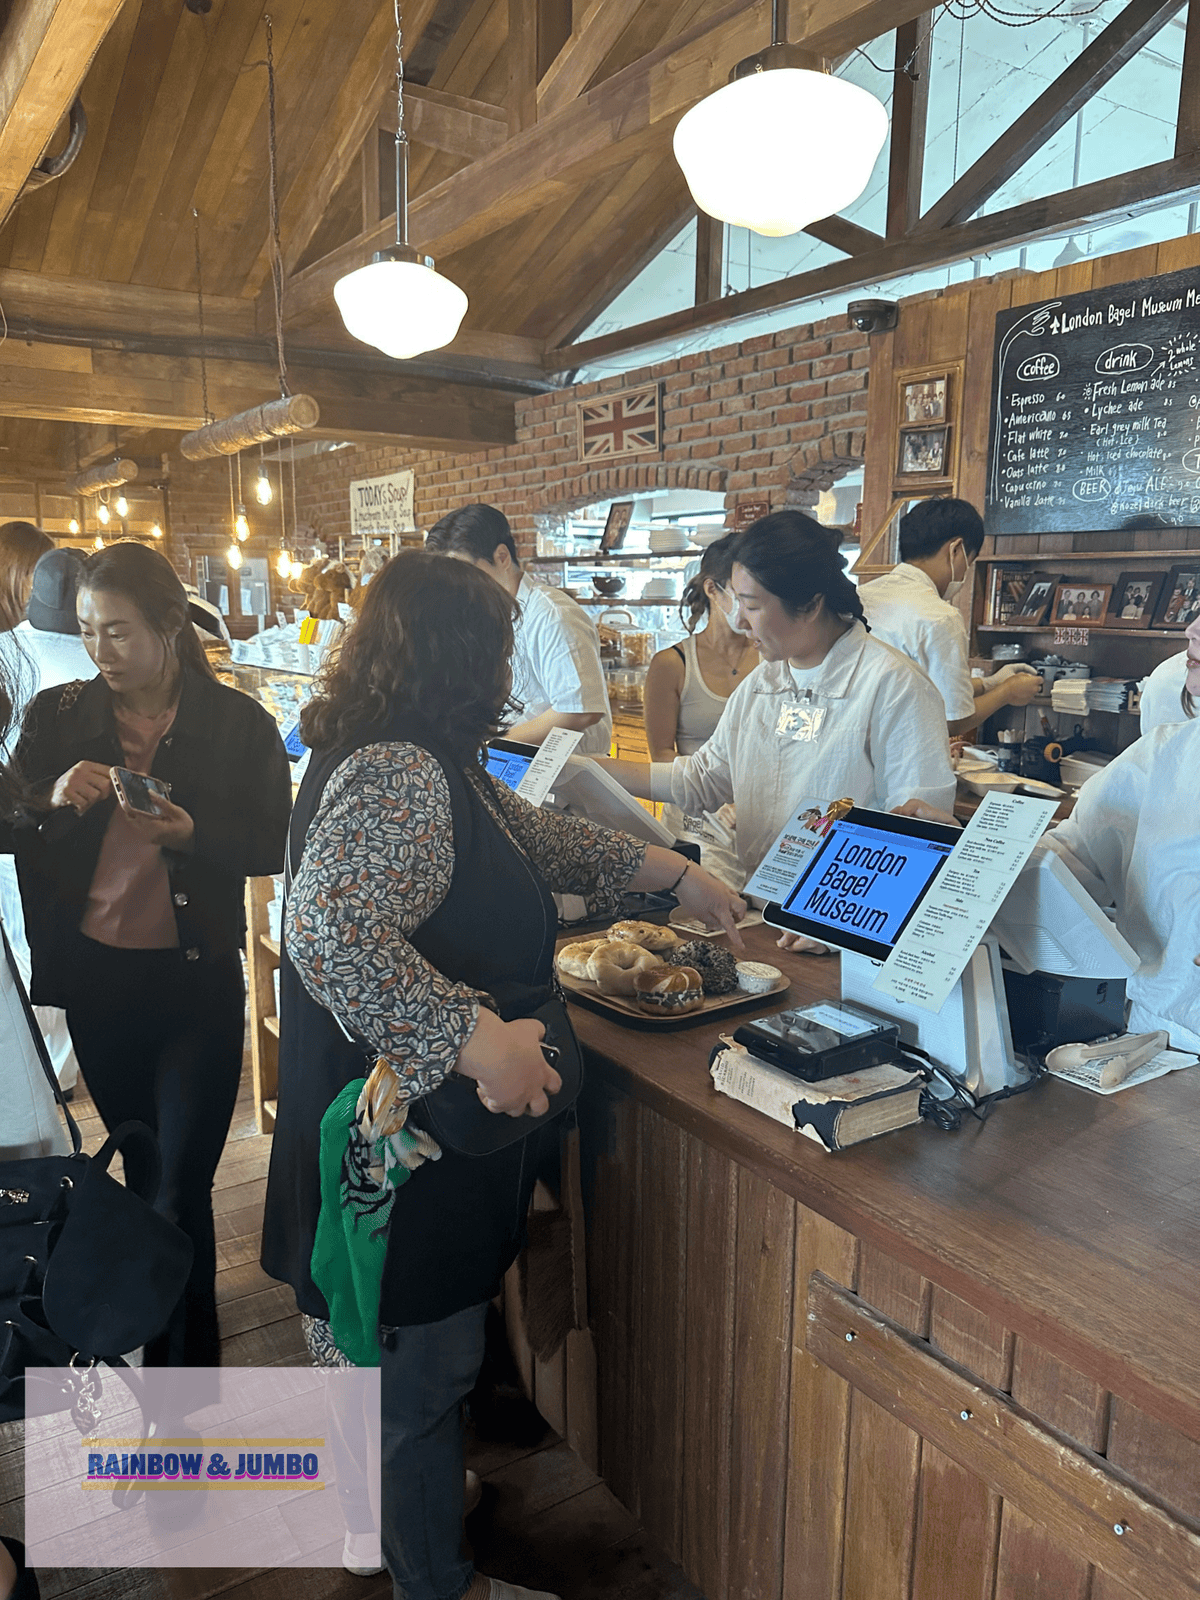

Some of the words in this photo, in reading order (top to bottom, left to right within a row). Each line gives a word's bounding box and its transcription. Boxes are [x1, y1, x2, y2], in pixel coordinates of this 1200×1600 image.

[1061, 307, 1102, 334] London
[1108, 301, 1135, 327] Bagel
[1141, 296, 1182, 318] Museum
[1023, 356, 1055, 377] coffee
[1105, 350, 1138, 370] drink
[1092, 381, 1117, 402] Fresh
[1121, 379, 1148, 394] Lemon
[1150, 373, 1165, 391] ade
[1011, 393, 1045, 413] Espresso
[1092, 401, 1122, 420] Lychee
[1128, 398, 1144, 412] ade
[1008, 410, 1056, 428] Americano
[1090, 423, 1109, 435] Earl
[1111, 423, 1130, 437] grey
[1154, 417, 1167, 429] Tea
[1007, 430, 1026, 446] Flat
[1029, 426, 1053, 441] white
[1007, 449, 1025, 462] Cafe
[1029, 447, 1050, 460] latte
[1125, 446, 1163, 459] chocolate
[1006, 466, 1025, 478] Oats
[1027, 462, 1050, 476] latte
[1080, 480, 1109, 496] BEER
[1004, 494, 1031, 509] Vanilla
[834, 837, 908, 877] London
[818, 862, 878, 898] Bagel
[803, 886, 889, 934] Museum
